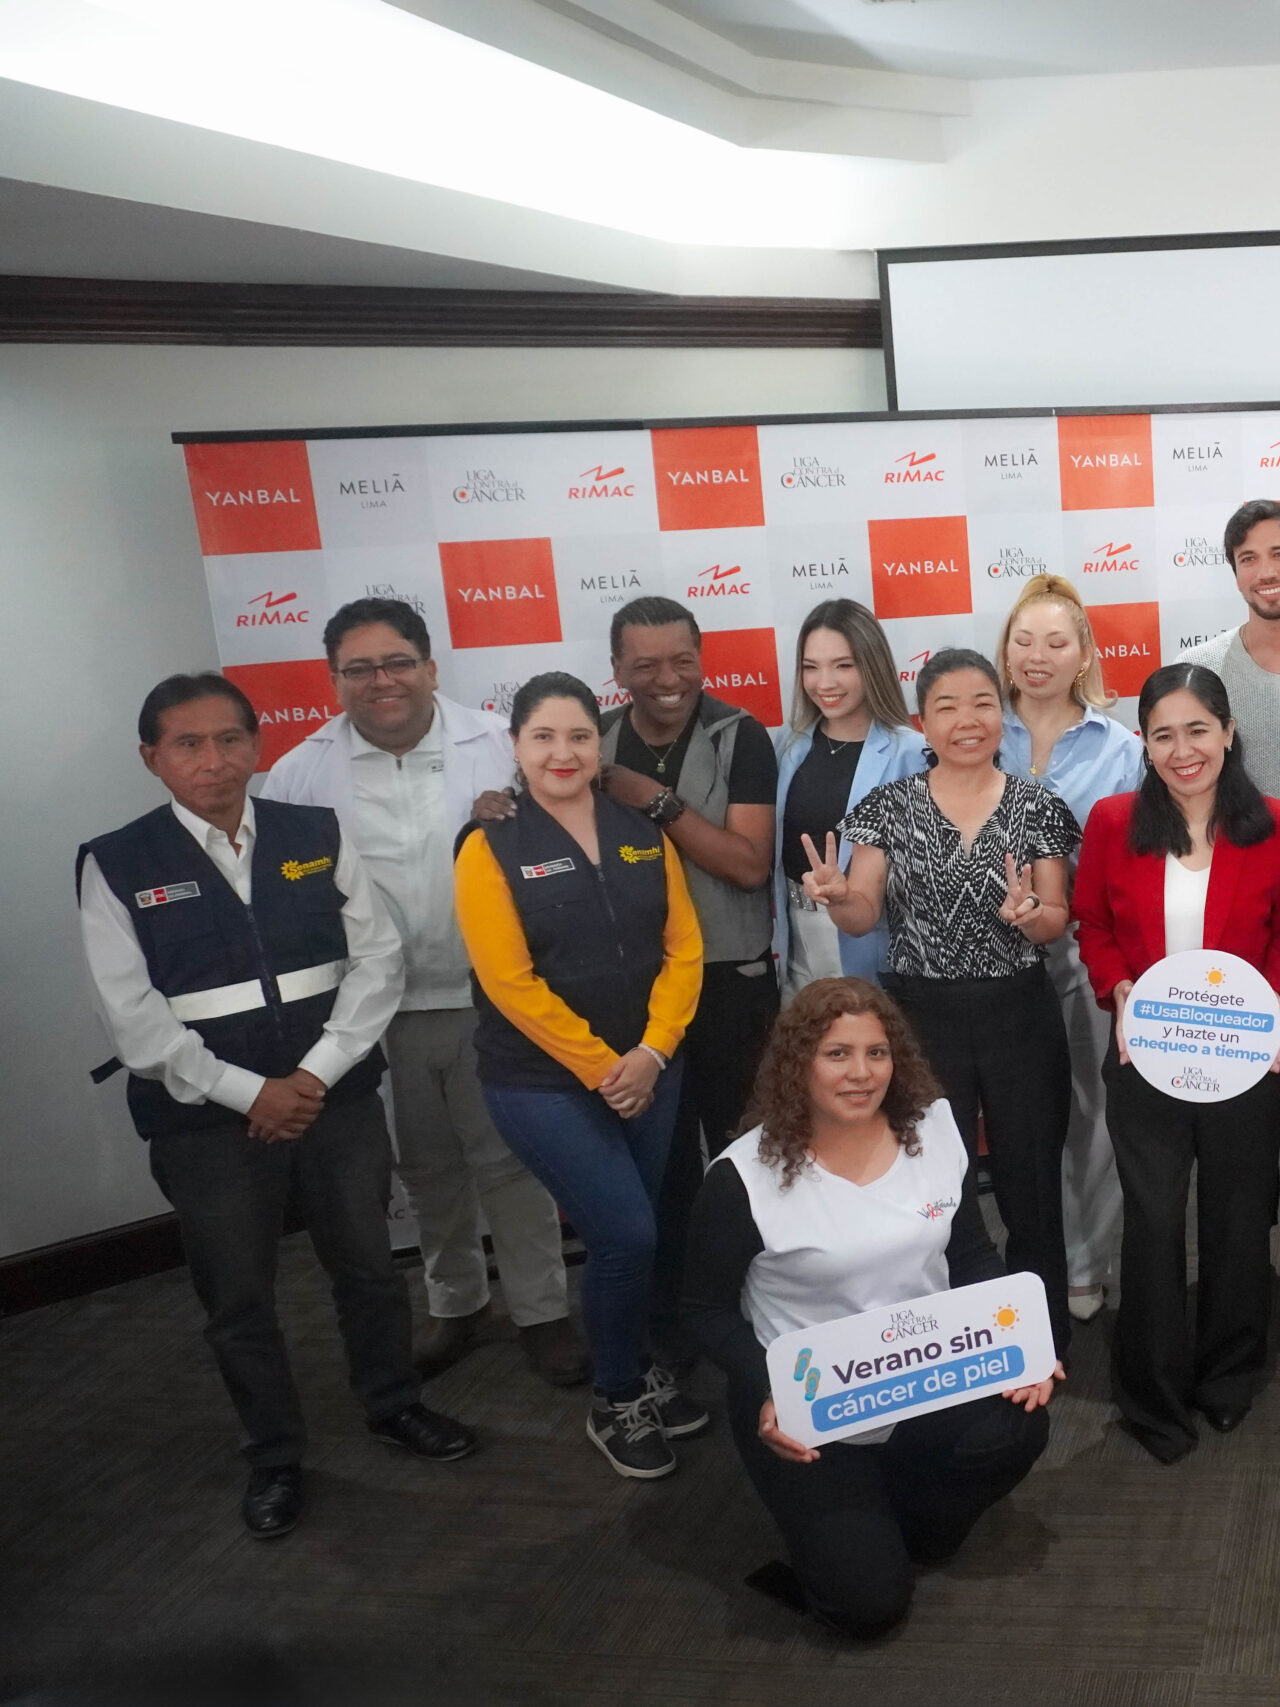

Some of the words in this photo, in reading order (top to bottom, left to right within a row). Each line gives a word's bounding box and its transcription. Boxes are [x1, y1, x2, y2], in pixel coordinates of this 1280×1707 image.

[793, 456, 820, 467] LIGA
[1070, 453, 1142, 469] YANBAL
[1187, 464, 1208, 472] LIMA
[466, 469, 495, 481] LIGA
[667, 469, 749, 486] YANBAL
[884, 470, 944, 484] RIMAC
[1001, 472, 1022, 480] LIMA
[205, 488, 300, 507] YANBAL
[568, 484, 635, 500] RIMAC
[361, 501, 387, 509] LIMA
[1185, 538, 1207, 547] LIGA
[1000, 547, 1024, 558] LIGA
[883, 559, 959, 577] YANBAL
[1083, 559, 1140, 574] RIMAC
[366, 584, 396, 596] LIGA
[457, 584, 545, 603] YANBAL
[687, 582, 751, 598] RIMAC
[810, 582, 833, 591] LIMA
[600, 594, 625, 604] LIMA
[236, 610, 310, 627] RIMAC
[1095, 643, 1150, 659] ANBAL
[701, 672, 768, 689] ANBAL
[596, 692, 631, 707] RIM
[258, 705, 335, 725] ANBAL
[1168, 987, 1245, 1007] Protégete
[1140, 1003, 1268, 1029] #UsaBloqueador
[1162, 1025, 1173, 1039] y
[1175, 1025, 1216, 1041] hazte
[1220, 1032, 1240, 1044] un
[1129, 1036, 1198, 1054] chequeo
[1201, 1045, 1211, 1055] a
[1215, 1044, 1271, 1063] tiempo
[832, 1341, 942, 1385] Verano
[949, 1326, 993, 1354] sin
[827, 1378, 918, 1422] cáncer
[923, 1369, 957, 1394] de
[963, 1351, 1009, 1388] piel
